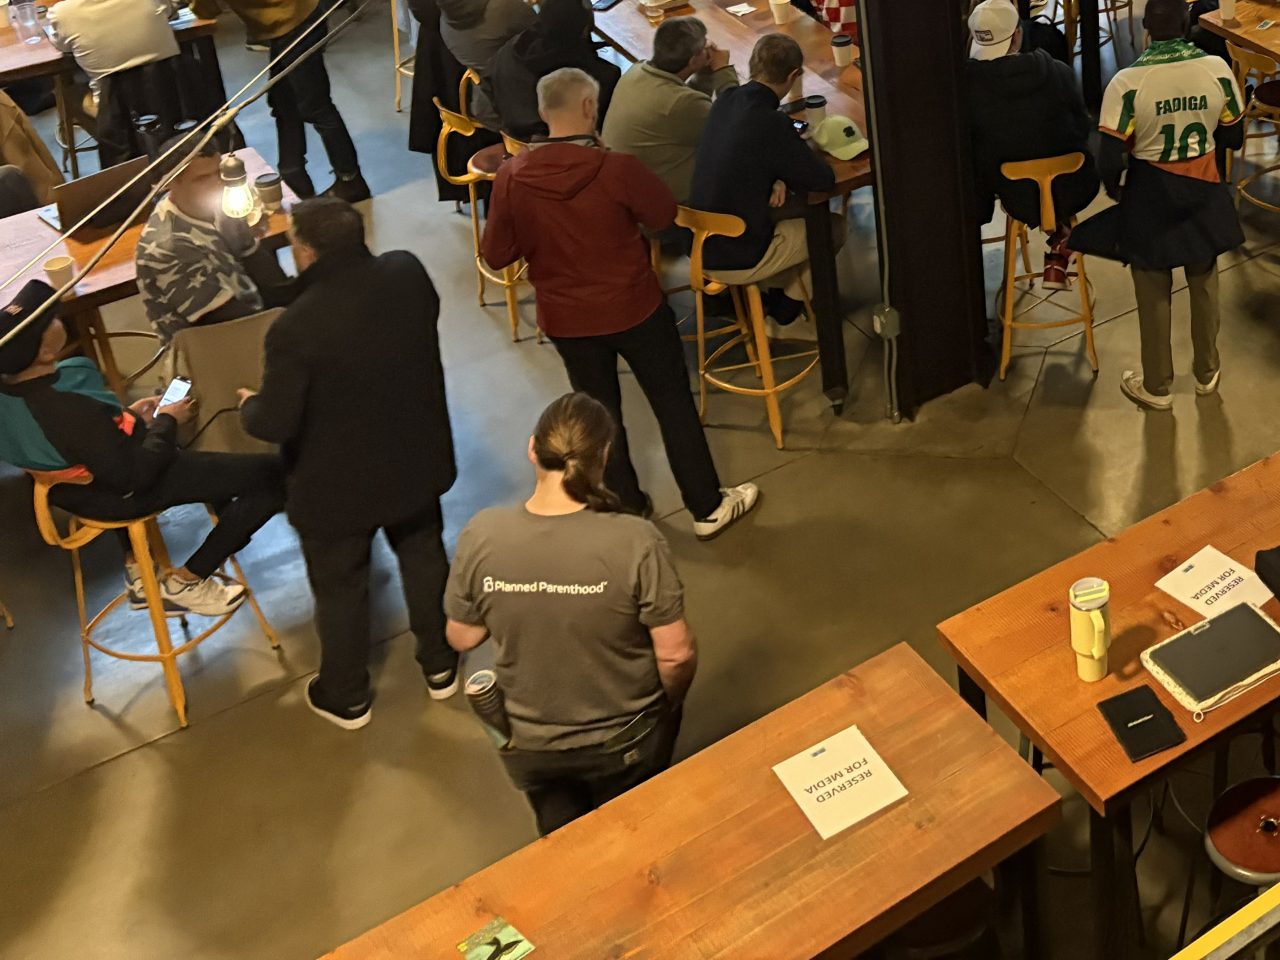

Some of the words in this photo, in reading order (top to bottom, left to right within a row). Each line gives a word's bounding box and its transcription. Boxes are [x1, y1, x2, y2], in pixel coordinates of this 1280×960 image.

[1155, 95, 1208, 116] FADIGA
[1158, 122, 1208, 161] 10
[1217, 567, 1236, 581] FOR
[494, 581, 538, 593] Planned
[538, 581, 604, 594] Parenthood
[1191, 581, 1220, 600] MEDIA
[1205, 576, 1245, 606] RESERVED
[844, 757, 869, 774] FOR
[804, 770, 844, 794] MEDIA
[816, 769, 873, 803] RESERVED
